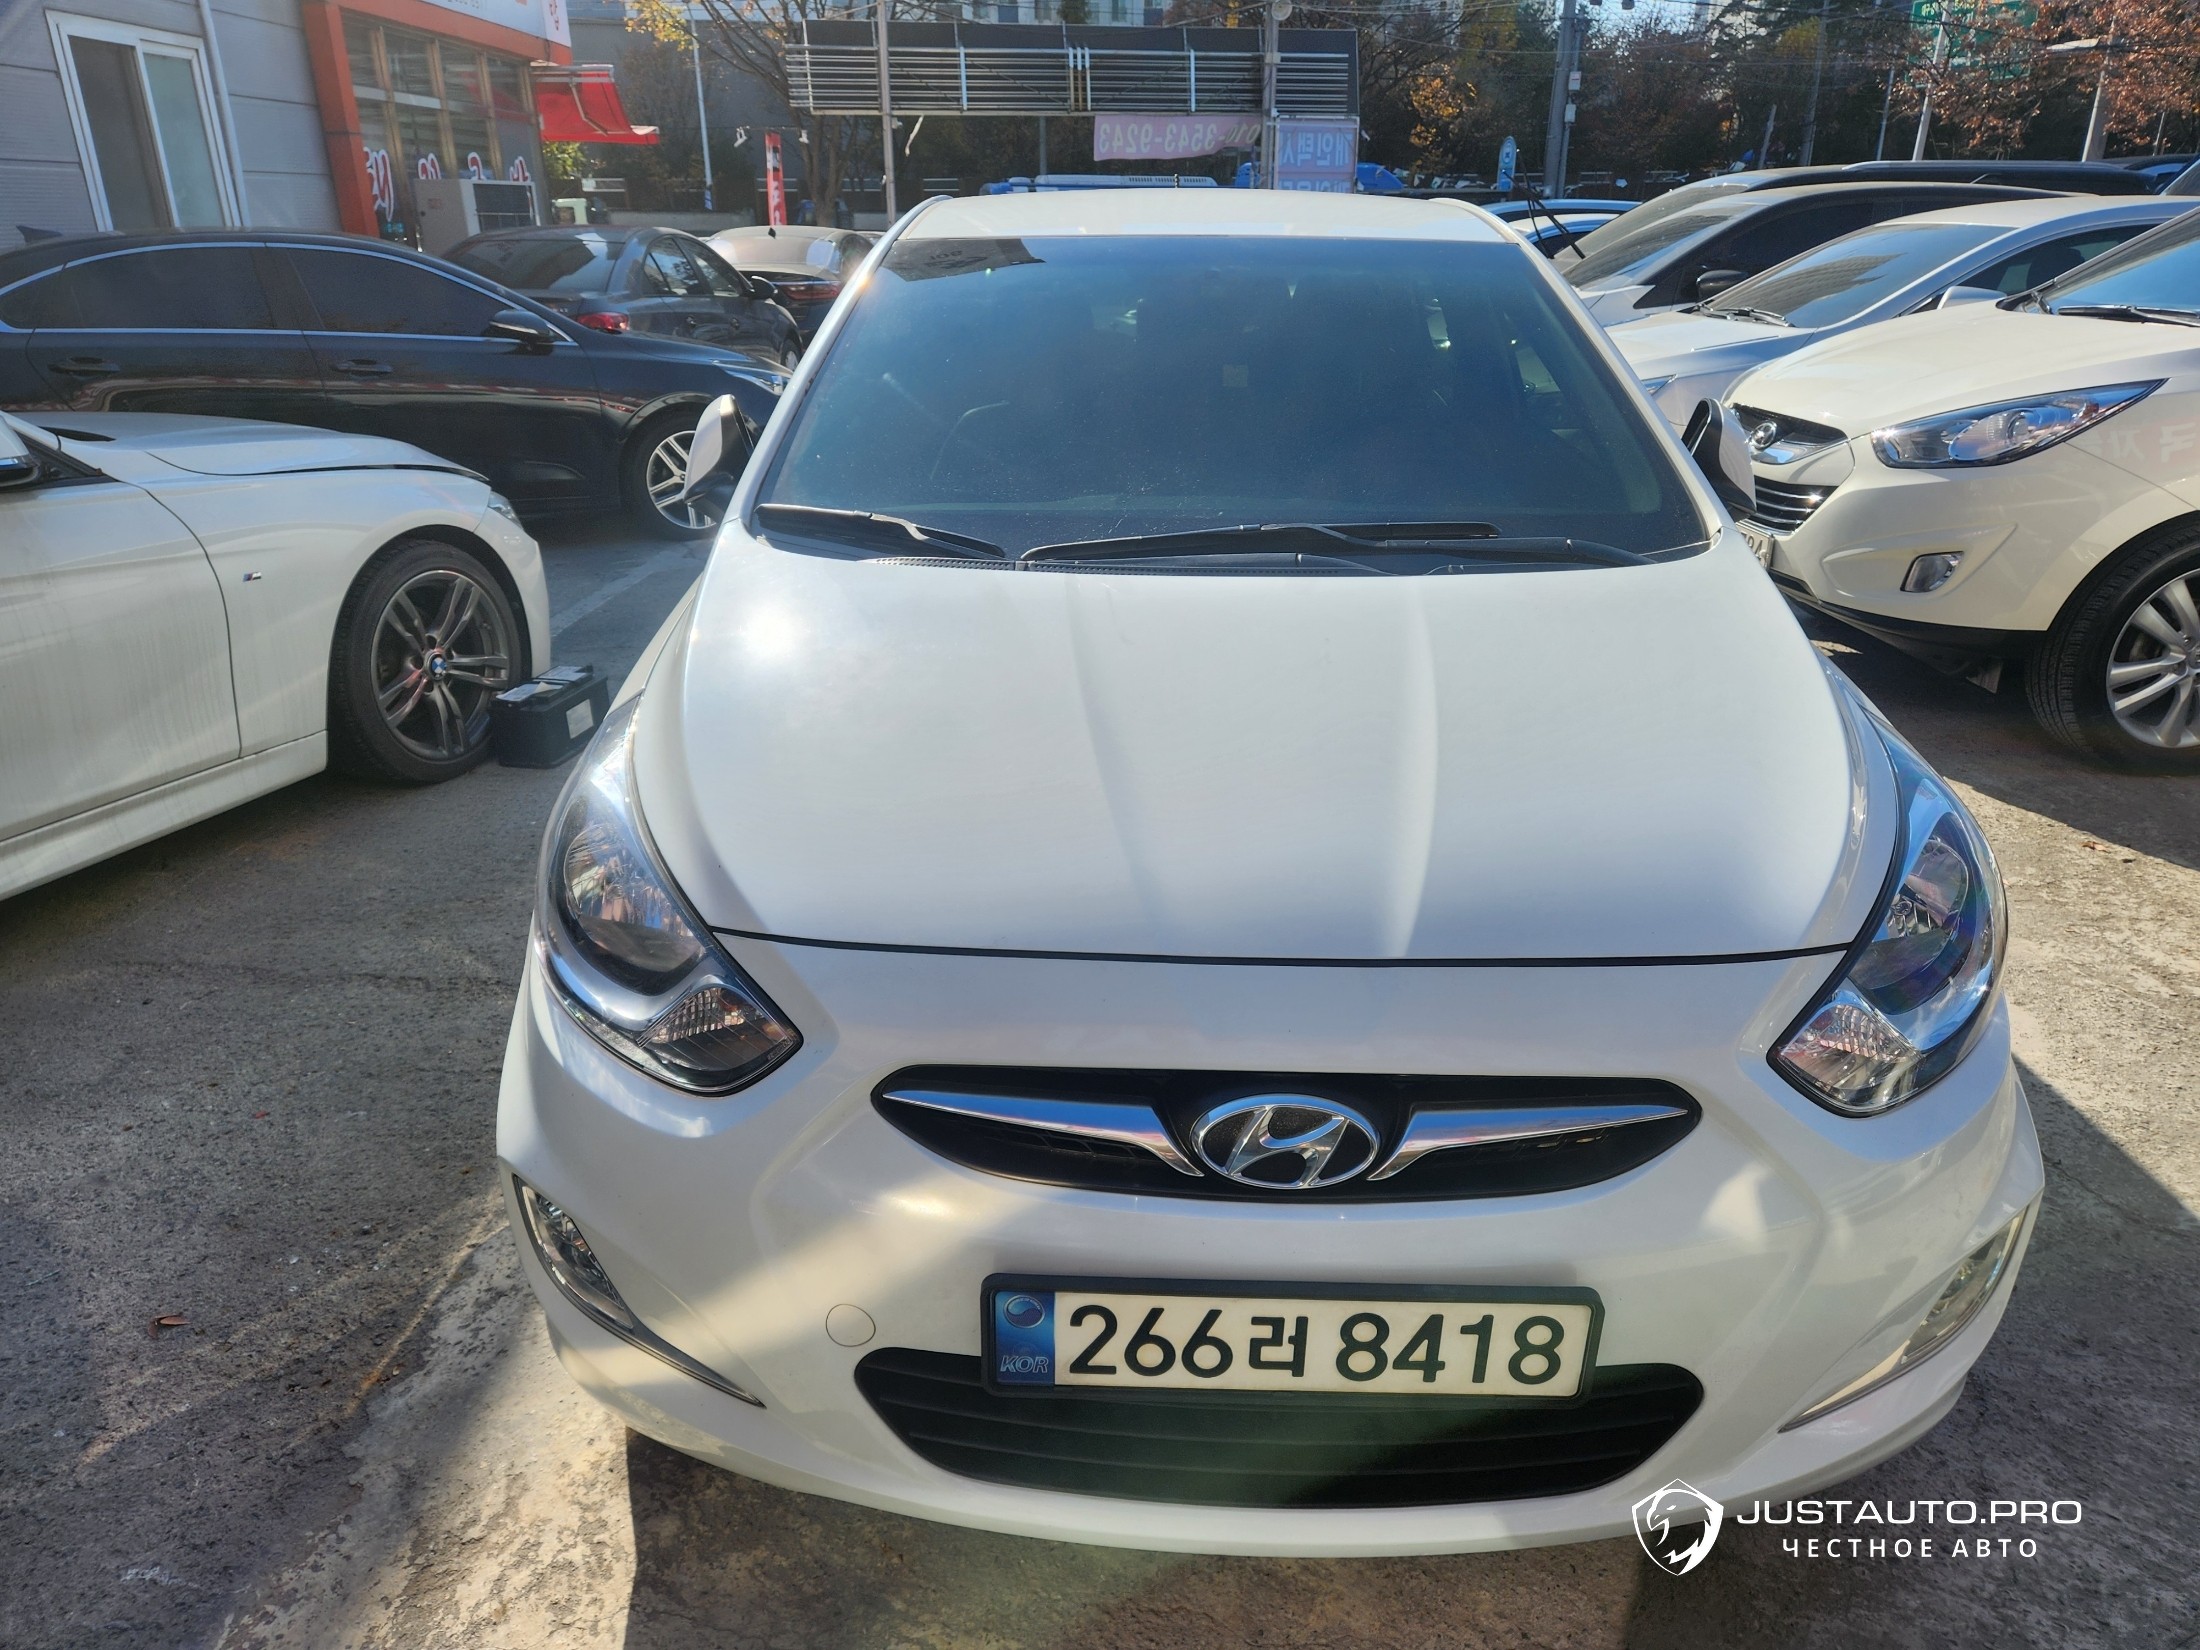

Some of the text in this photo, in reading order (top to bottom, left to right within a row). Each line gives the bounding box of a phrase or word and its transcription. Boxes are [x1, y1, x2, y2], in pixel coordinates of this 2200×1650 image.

[1000, 1355, 1048, 1373] KOR
[1070, 1305, 1564, 1384] 266러 8418
